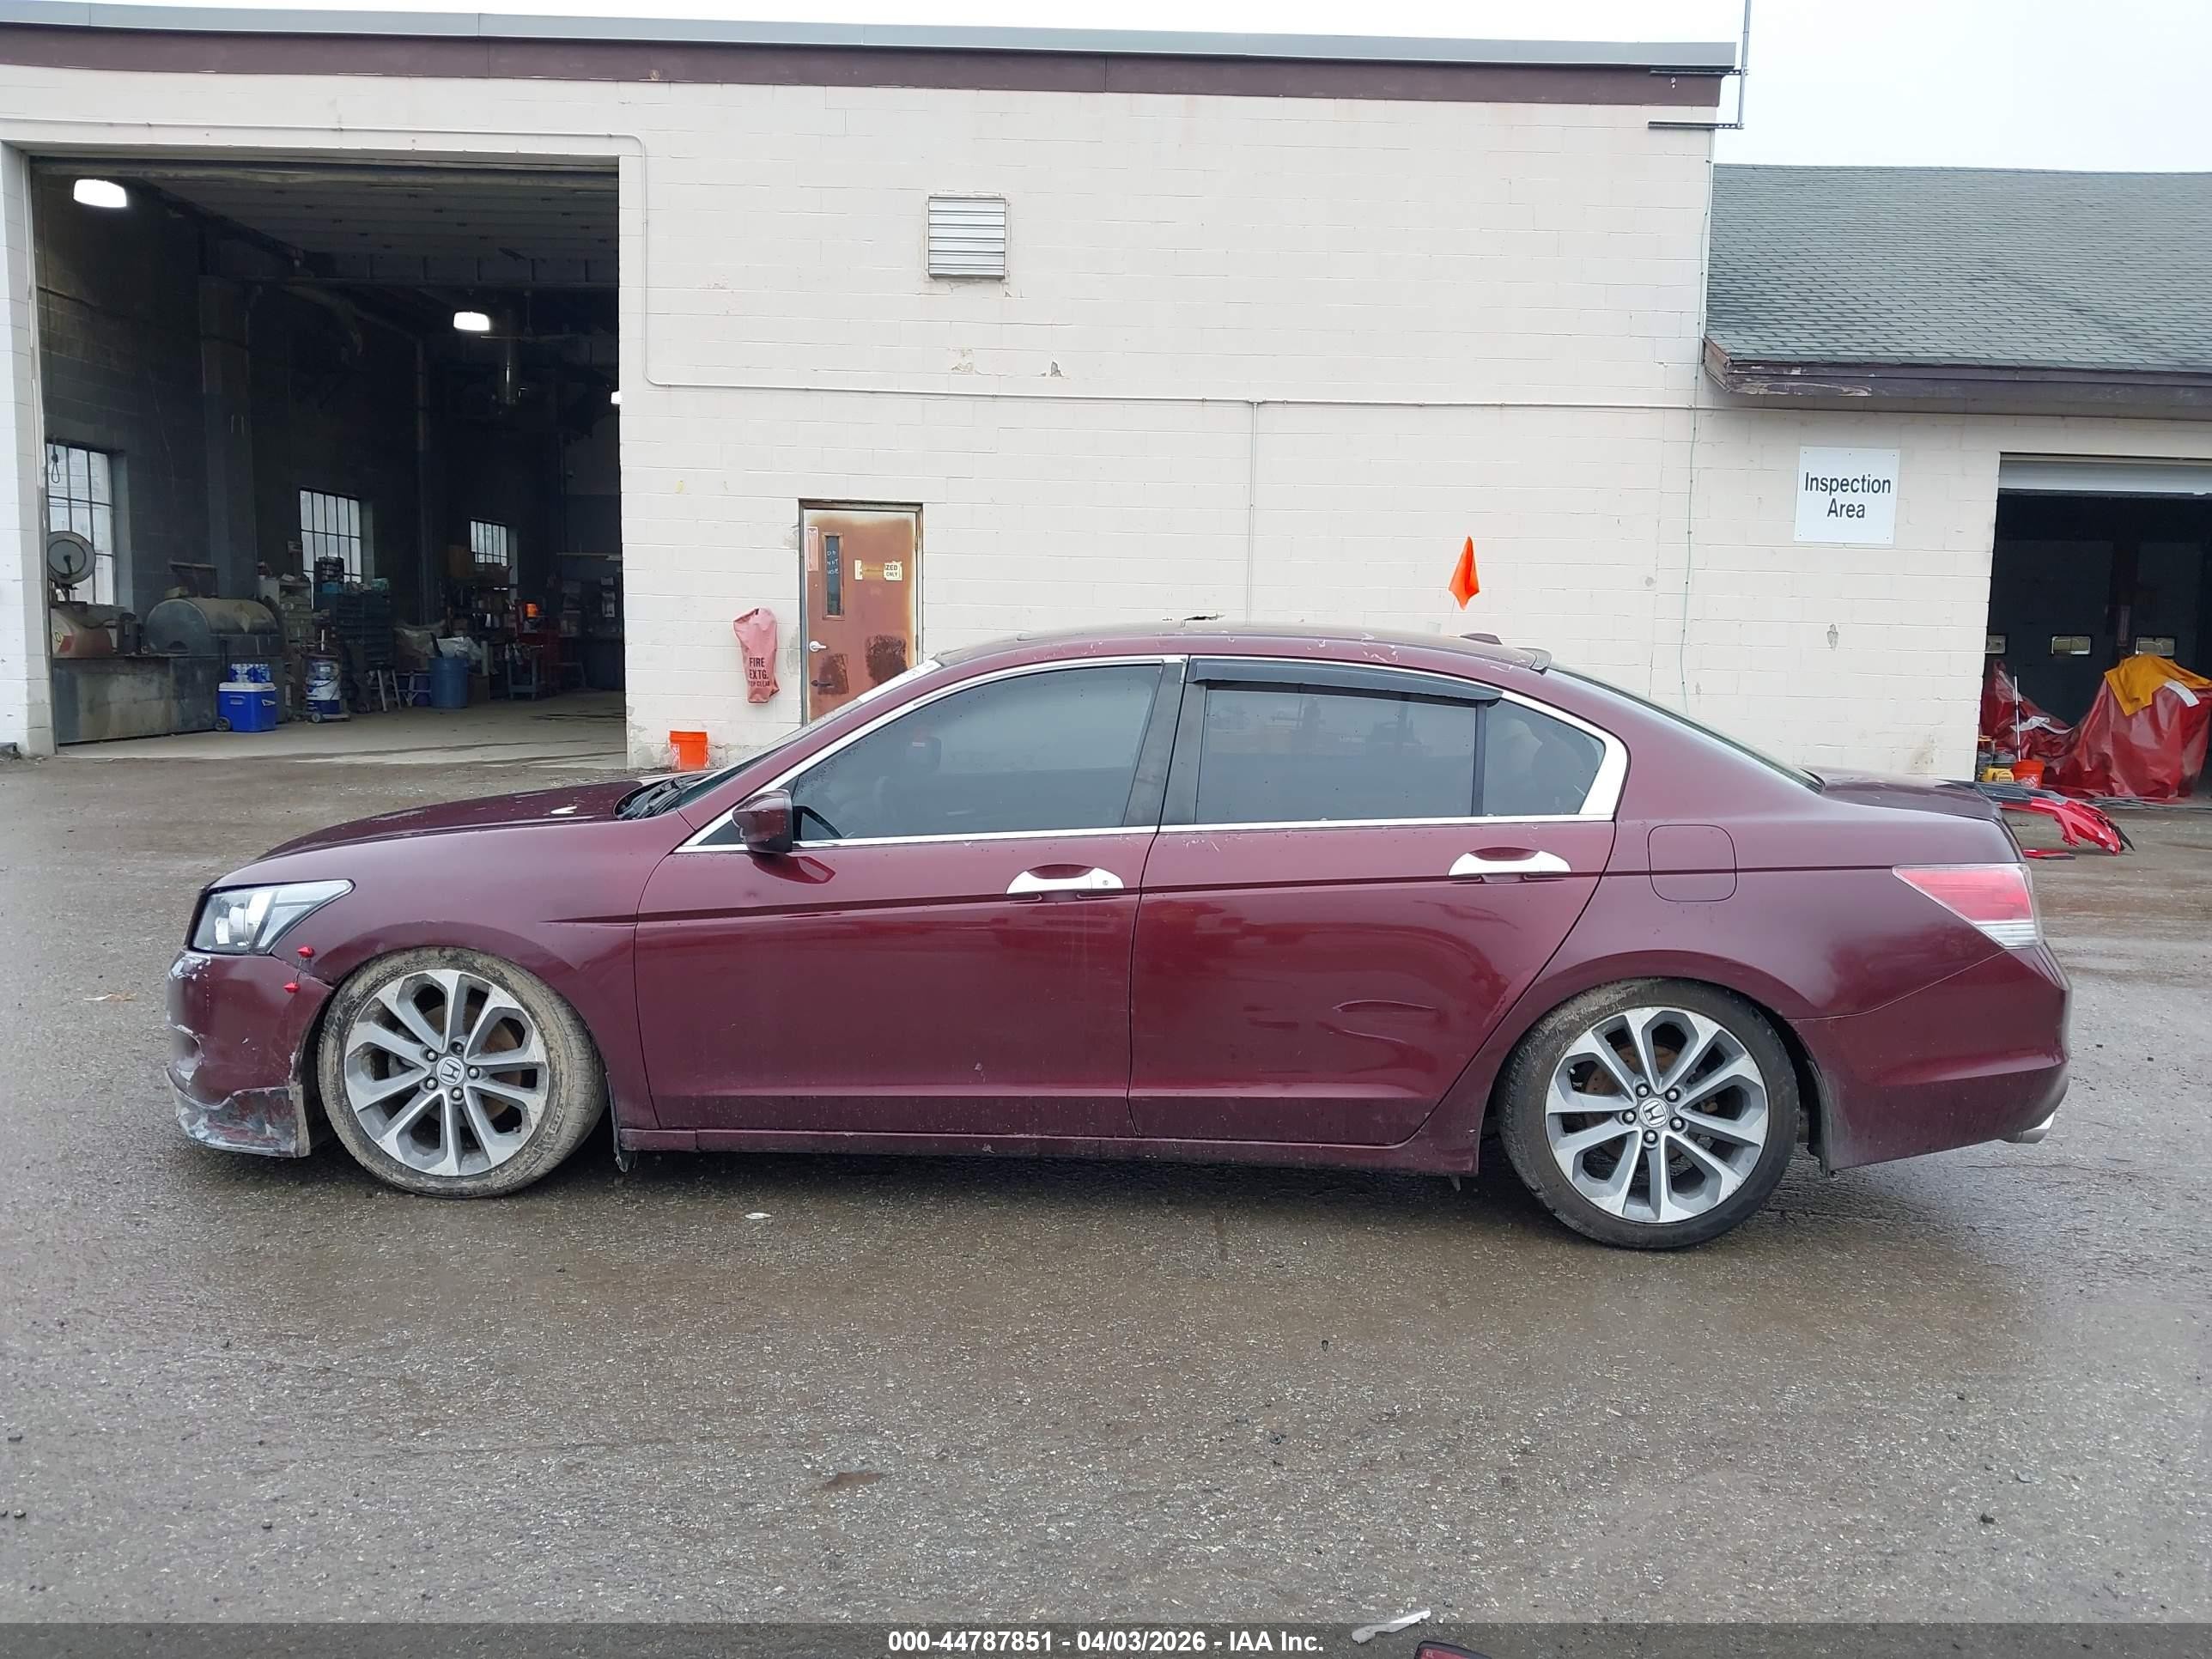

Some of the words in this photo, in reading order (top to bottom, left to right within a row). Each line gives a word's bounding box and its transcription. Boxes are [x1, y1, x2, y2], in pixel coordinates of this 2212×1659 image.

[1805, 471, 1891, 495] Inspection
[1827, 498, 1865, 518] Area
[749, 658, 765, 667] FIRE
[749, 669, 769, 679] EXTG.
